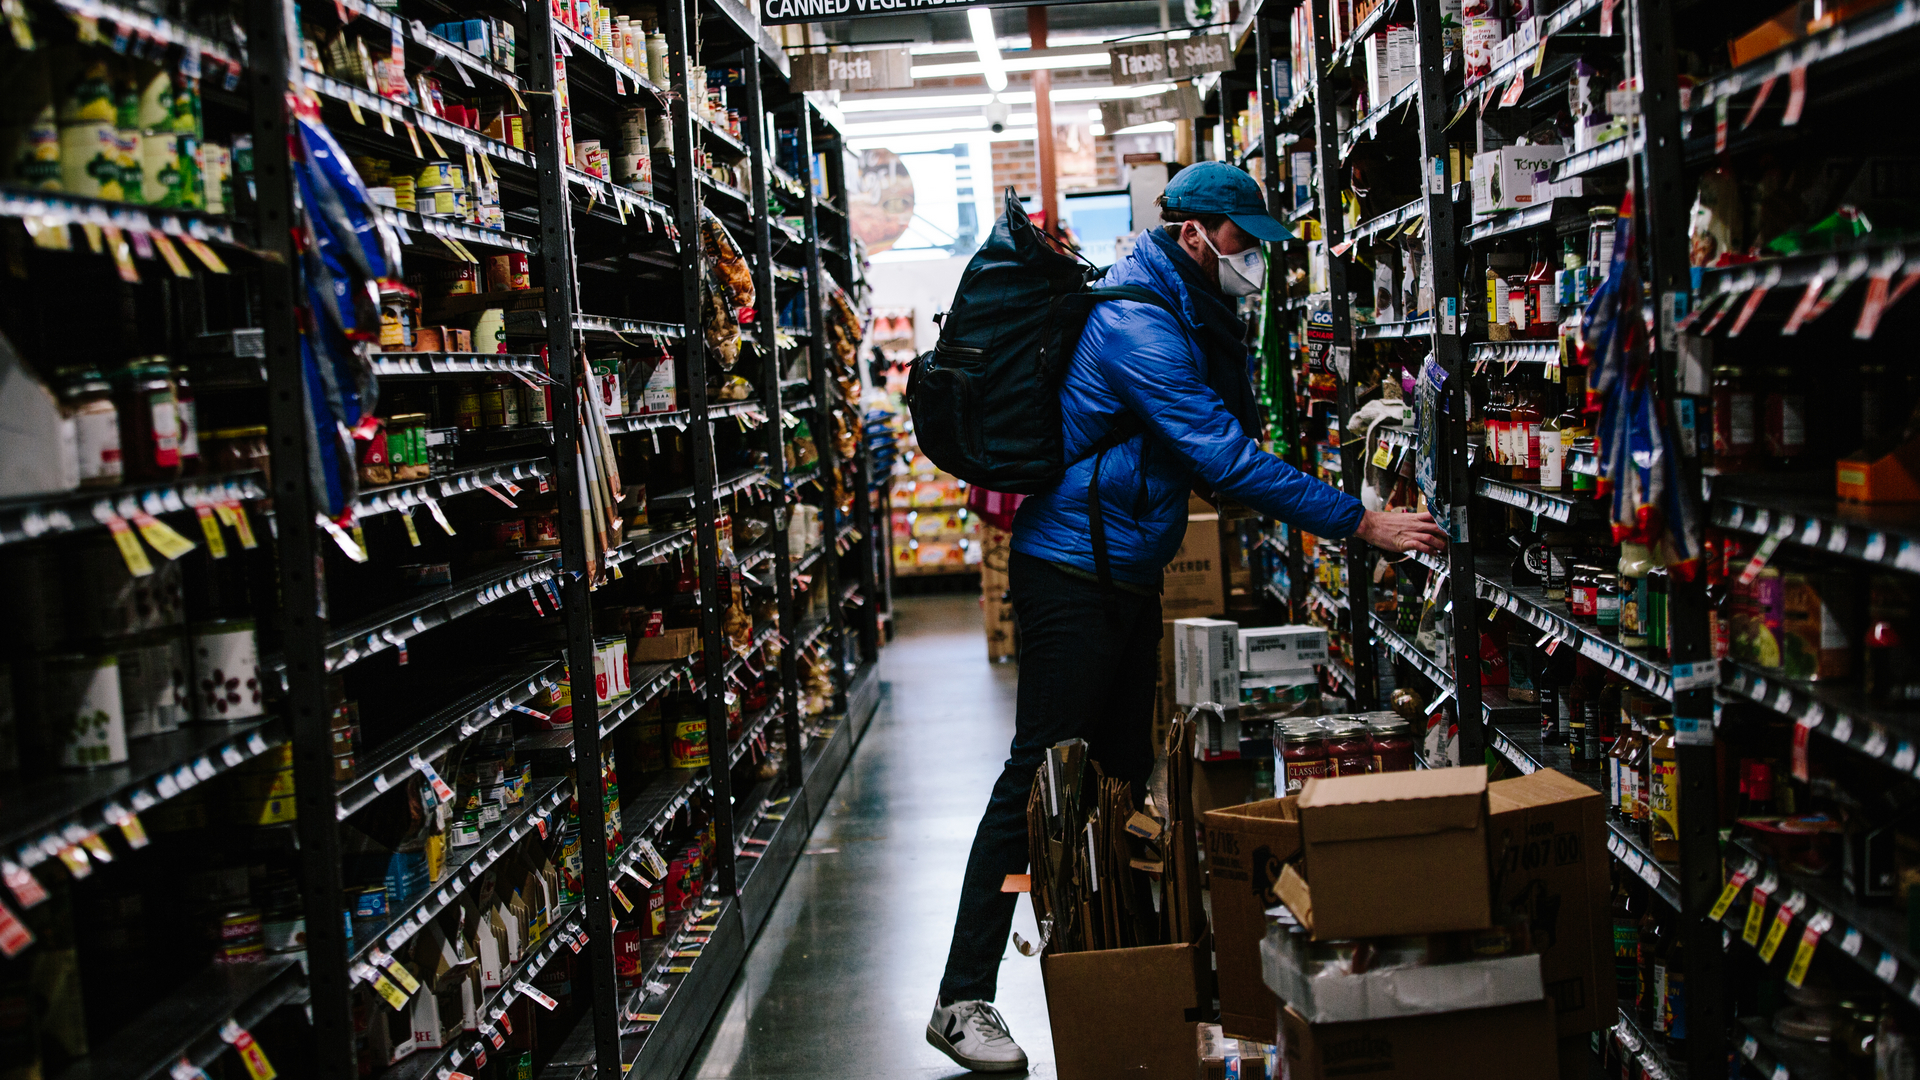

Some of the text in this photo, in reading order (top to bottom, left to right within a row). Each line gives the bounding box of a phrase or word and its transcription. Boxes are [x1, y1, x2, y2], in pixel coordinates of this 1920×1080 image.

[765, 0, 850, 19] CANNED
[829, 58, 872, 80] Pasta
[1118, 43, 1224, 76] Tacos & Salsa
[1289, 765, 1325, 777] CLASSICO
